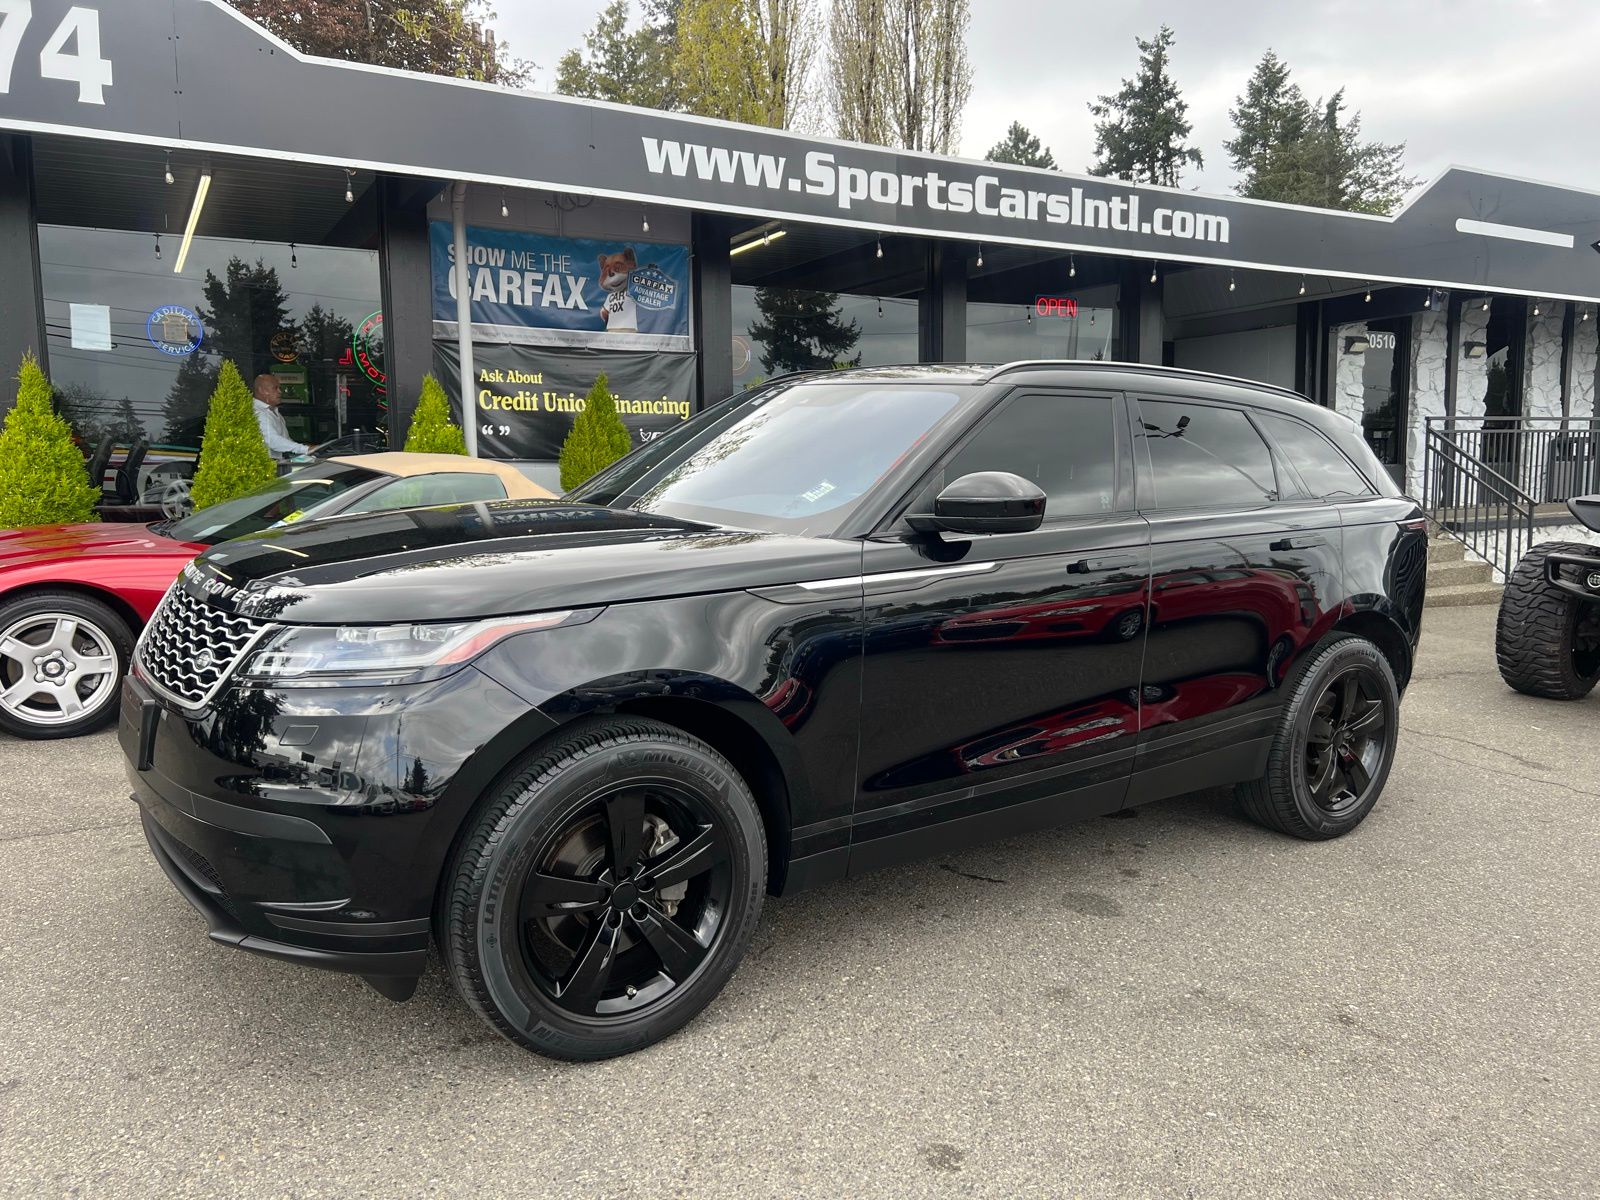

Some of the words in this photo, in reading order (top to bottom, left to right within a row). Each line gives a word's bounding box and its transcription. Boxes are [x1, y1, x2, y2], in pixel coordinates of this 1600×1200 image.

[0, 0, 113, 105] 74
[641, 137, 1230, 243] www.SportsCarsIntl.com
[511, 250, 536, 271] ME
[540, 252, 572, 274] THE
[632, 275, 674, 294] CARFAX
[634, 285, 670, 302] ADVANTAGE
[609, 301, 624, 313] FOX
[637, 295, 662, 308] DEALER
[1037, 297, 1077, 318] OPEN
[151, 307, 199, 326] CADILLAC
[158, 340, 196, 354] SERVICE
[480, 369, 503, 382] Ask
[506, 370, 543, 385] About
[479, 390, 539, 412] Credit
[543, 392, 587, 412] Unio
[608, 394, 691, 420] inancing
[202, 578, 265, 606] ROVER
